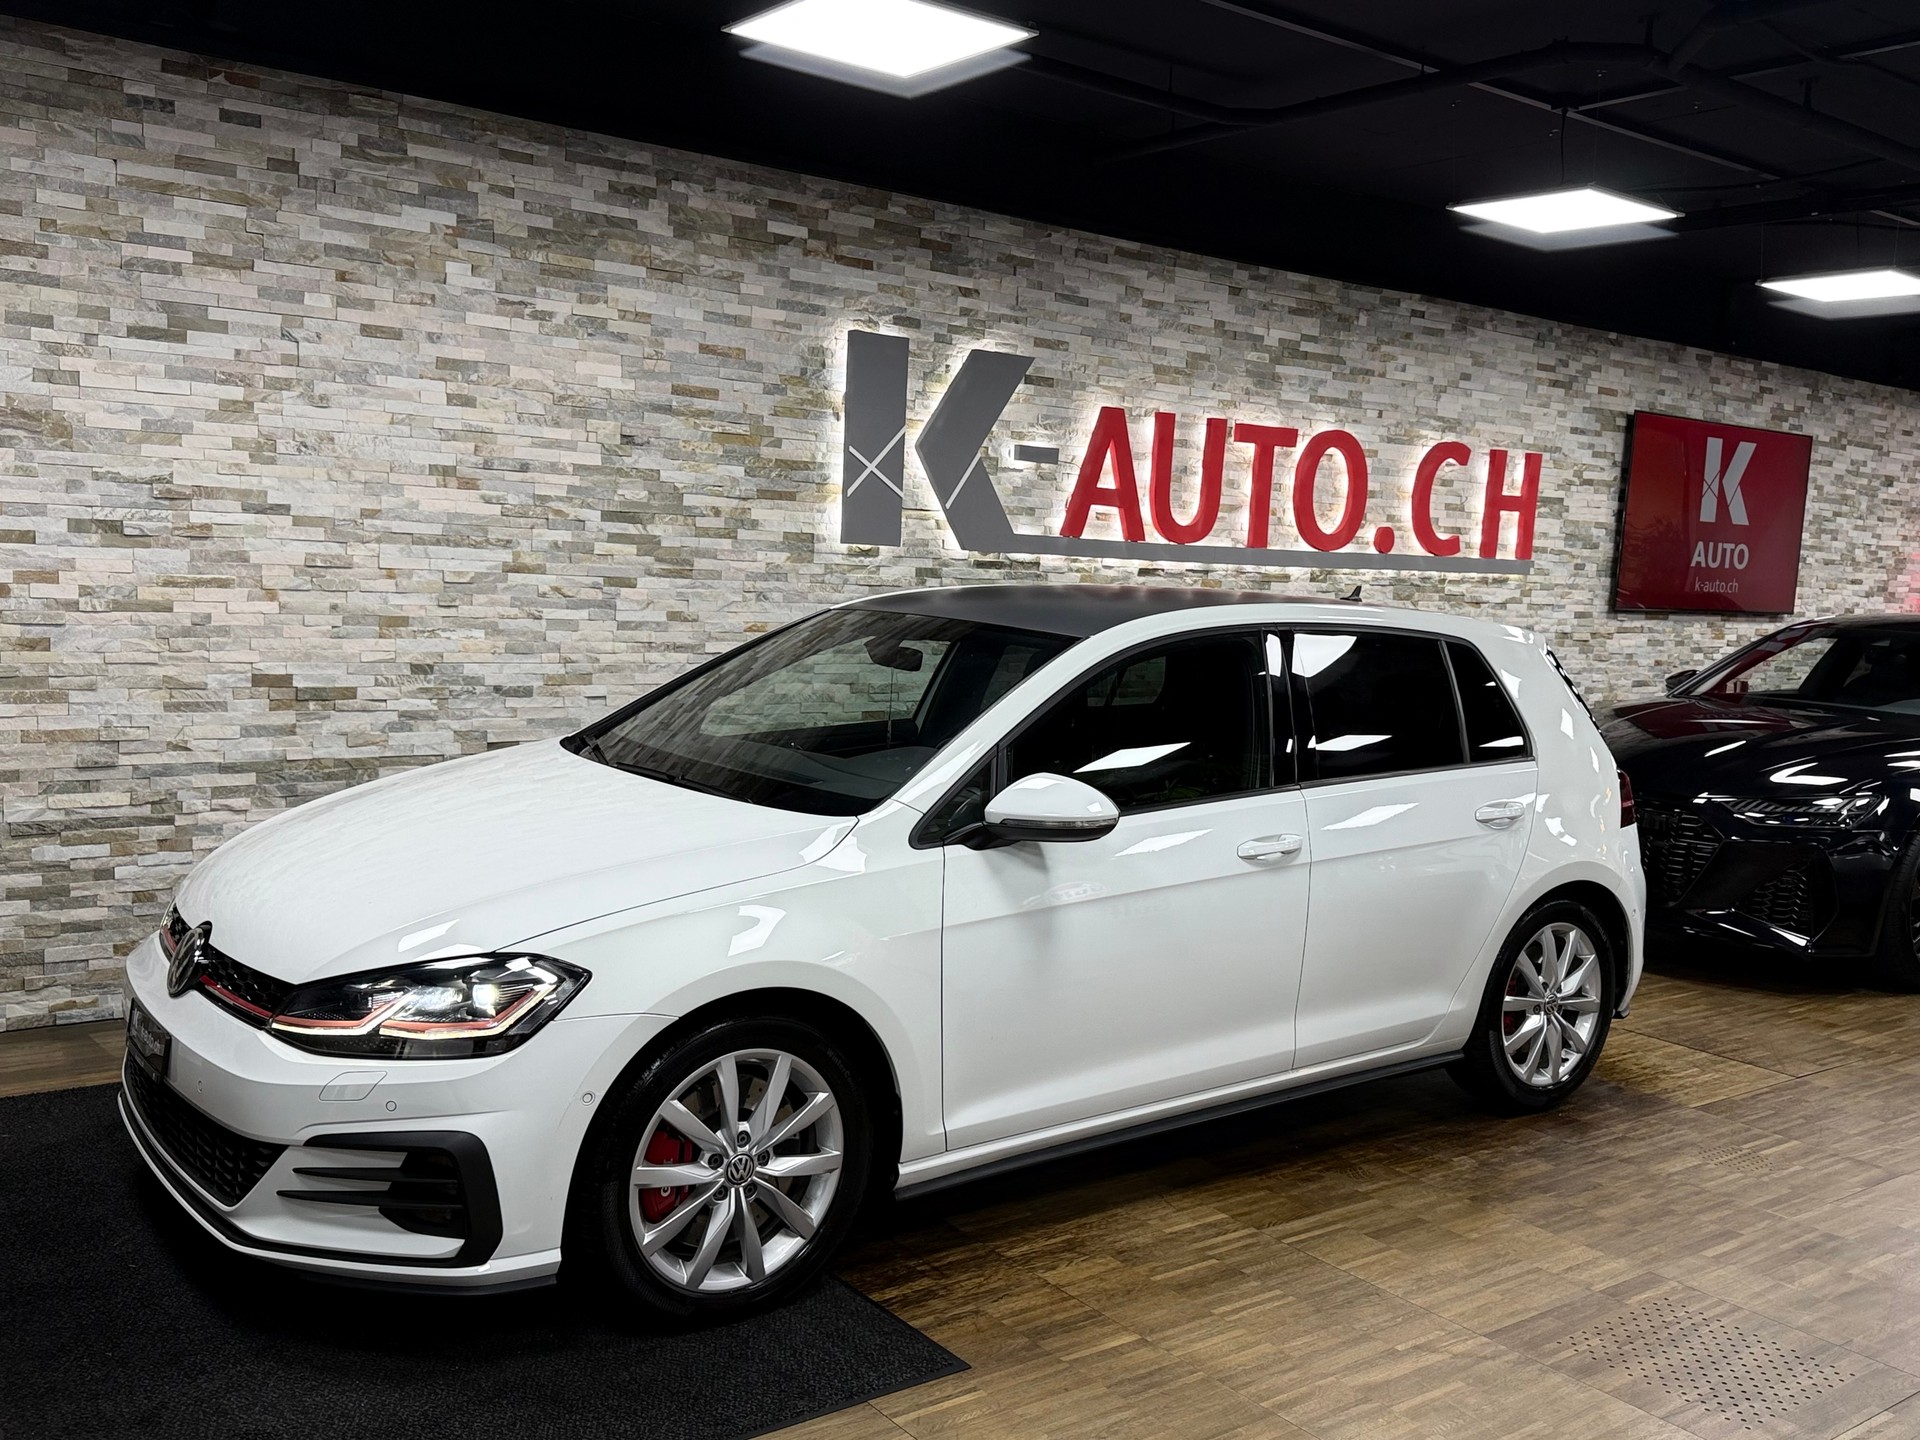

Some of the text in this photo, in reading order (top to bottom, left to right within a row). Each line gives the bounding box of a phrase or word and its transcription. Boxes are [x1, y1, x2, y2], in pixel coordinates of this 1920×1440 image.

[1700, 436, 1757, 526] K
[1690, 541, 1749, 570] AUTO
[1694, 576, 1739, 593] k-auto.ch
[727, 1153, 754, 1184] VW
